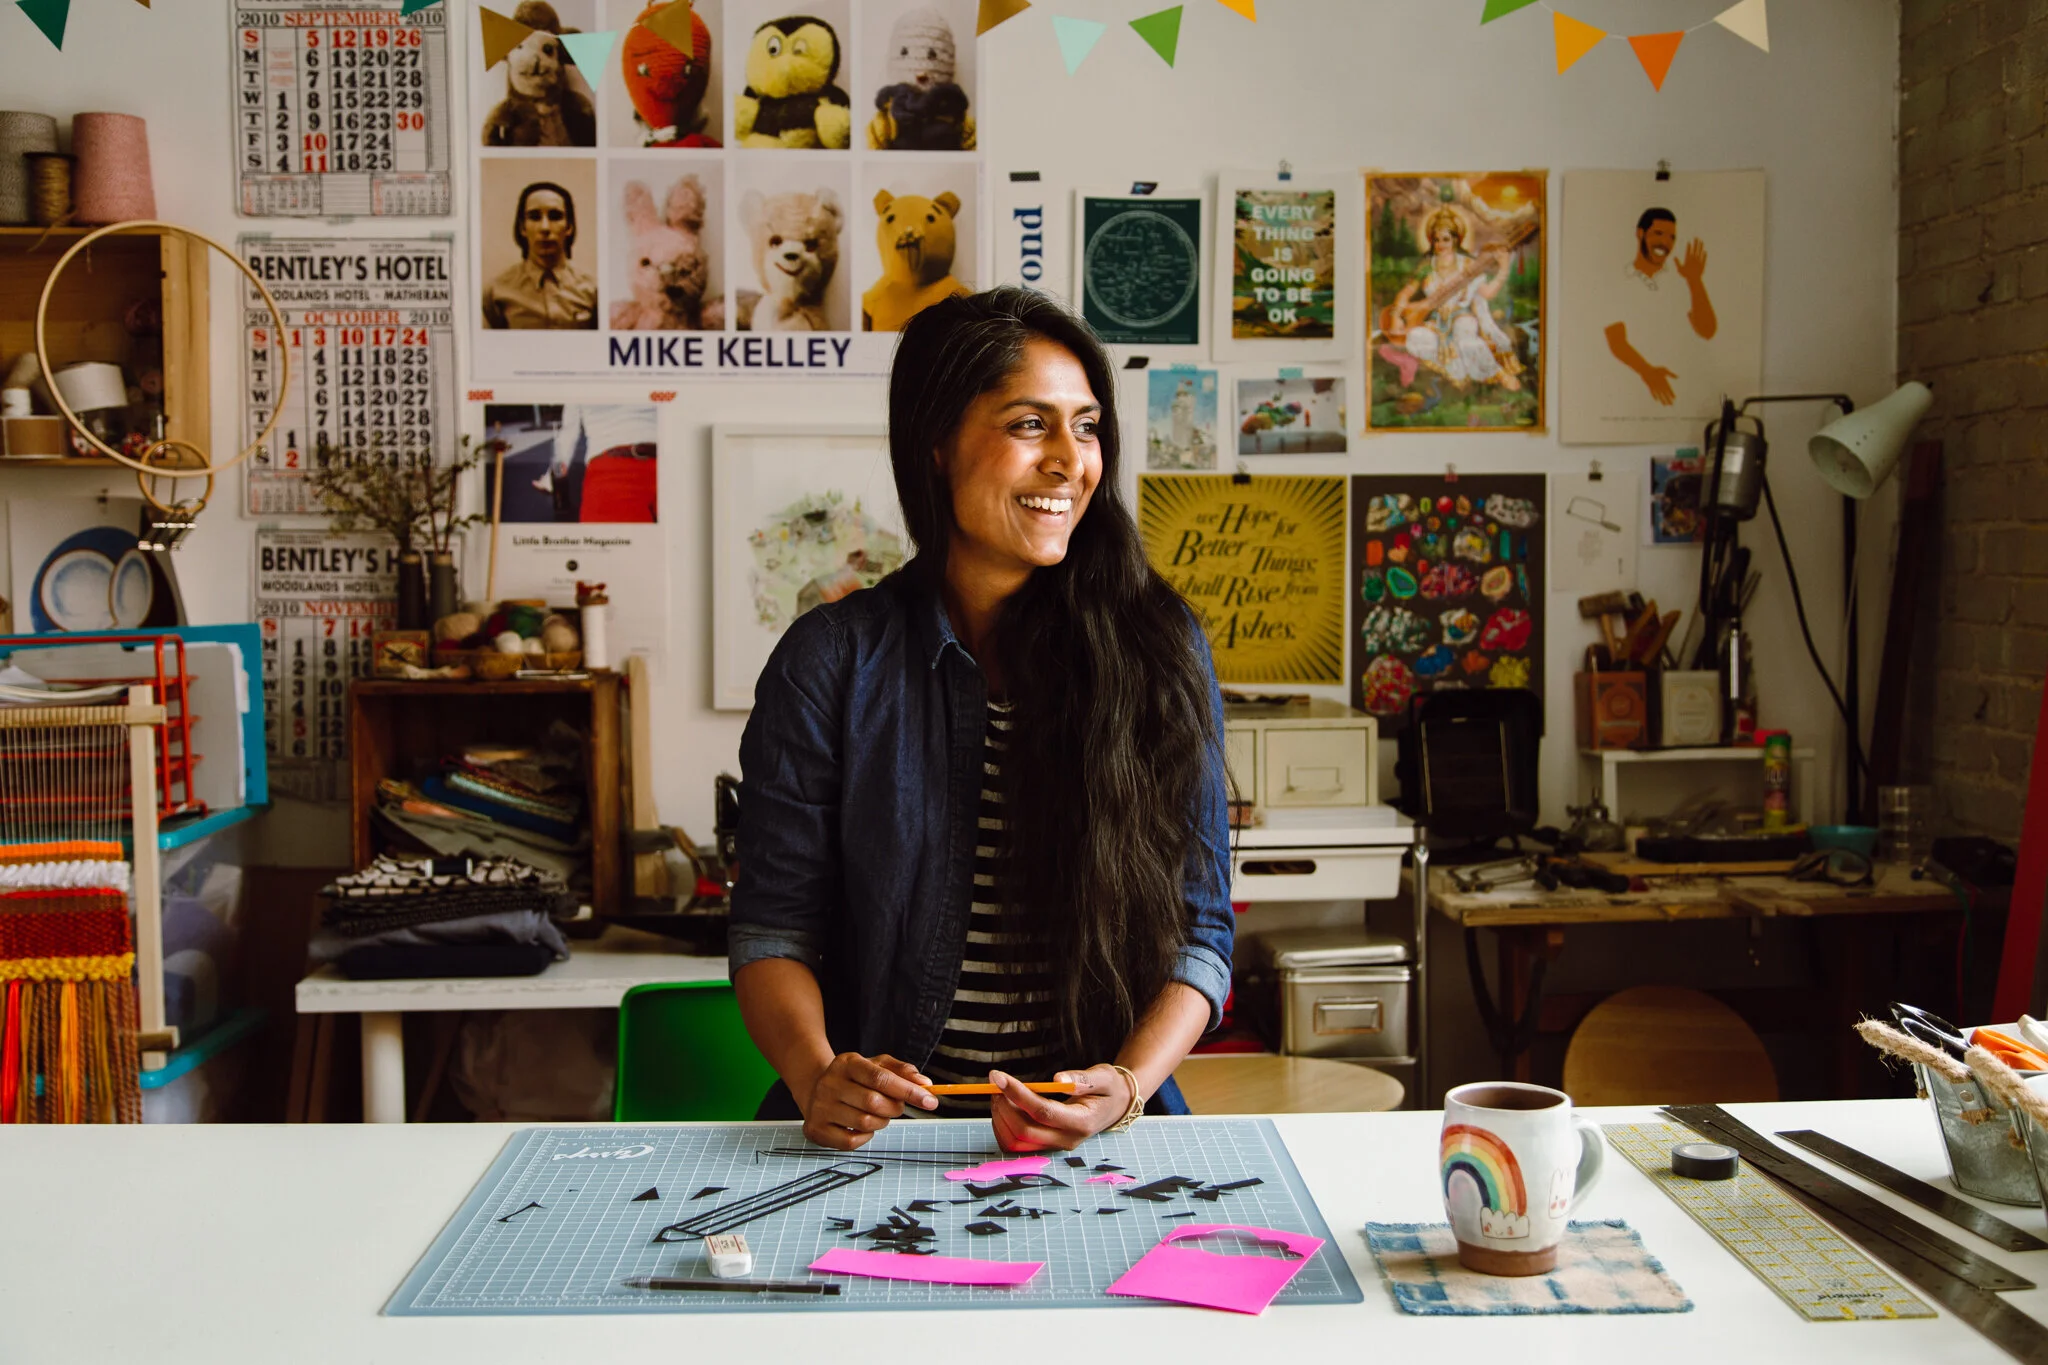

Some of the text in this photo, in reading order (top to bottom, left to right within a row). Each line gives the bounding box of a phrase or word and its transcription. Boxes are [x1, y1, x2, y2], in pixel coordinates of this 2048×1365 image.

[241, 11, 442, 26] 2010 SEPTEMBER 2010
[244, 30, 422, 48] S 5 12 19 26
[244, 50, 420, 67] M 6 13 20 27
[243, 70, 422, 89] T 7 14 21 28
[243, 91, 423, 111] W 1 8 15 22 29
[246, 112, 424, 130] T 2 9 16 23 30
[248, 133, 391, 152] F 3 10 17 24
[248, 154, 392, 173] S 4 11 18 25
[1252, 205, 1315, 219] EVERY
[1253, 226, 1314, 241] THING
[1014, 205, 1043, 291] ond
[1273, 247, 1292, 262] IS
[250, 256, 448, 280] BENTLEY'S HOTEL
[1251, 268, 1315, 282] GOING
[252, 290, 448, 300] WODLANDS HOTEL MATHERAN
[1254, 287, 1312, 302] TO BE
[304, 311, 399, 324] OCTOBER
[409, 311, 449, 324] 2010
[1268, 308, 1297, 323] OK
[253, 330, 267, 343] S
[314, 330, 326, 346] 3
[341, 329, 363, 345] 10
[372, 329, 396, 345] 17
[403, 328, 427, 345] 24
[252, 349, 427, 366] M 4 11 18 25
[609, 337, 852, 367] MIKE KELLEY
[253, 370, 428, 386] T 5 12 19 26
[253, 390, 428, 406] W 6 13 20 27
[254, 410, 430, 427] T 7 14 21 28
[287, 431, 296, 448] 1
[343, 431, 367, 447] 15
[373, 431, 398, 446] 22
[404, 430, 431, 446] 29
[286, 451, 298, 468] 2
[1217, 503, 1278, 534] Hope
[513, 535, 632, 548] Little Brother Magazine
[1170, 529, 1248, 567] Better
[262, 547, 379, 572] BENTLEY'S
[262, 580, 380, 592] WOODLANDS HOTEL
[1222, 576, 1281, 607] Rise
[262, 602, 300, 614] 2010
[263, 618, 276, 632] S
[322, 619, 336, 637] 7
[351, 620, 373, 638] 14
[264, 639, 277, 650] M
[295, 639, 303, 657] 1
[324, 639, 337, 656] 8
[263, 659, 277, 670] T
[293, 659, 305, 676] 2
[325, 659, 338, 677] 9
[292, 679, 305, 696] 3
[320, 679, 342, 696] 10
[291, 701, 304, 716] 4
[320, 700, 342, 717] 11
[1817, 1291, 1885, 1302] Omnigrid
